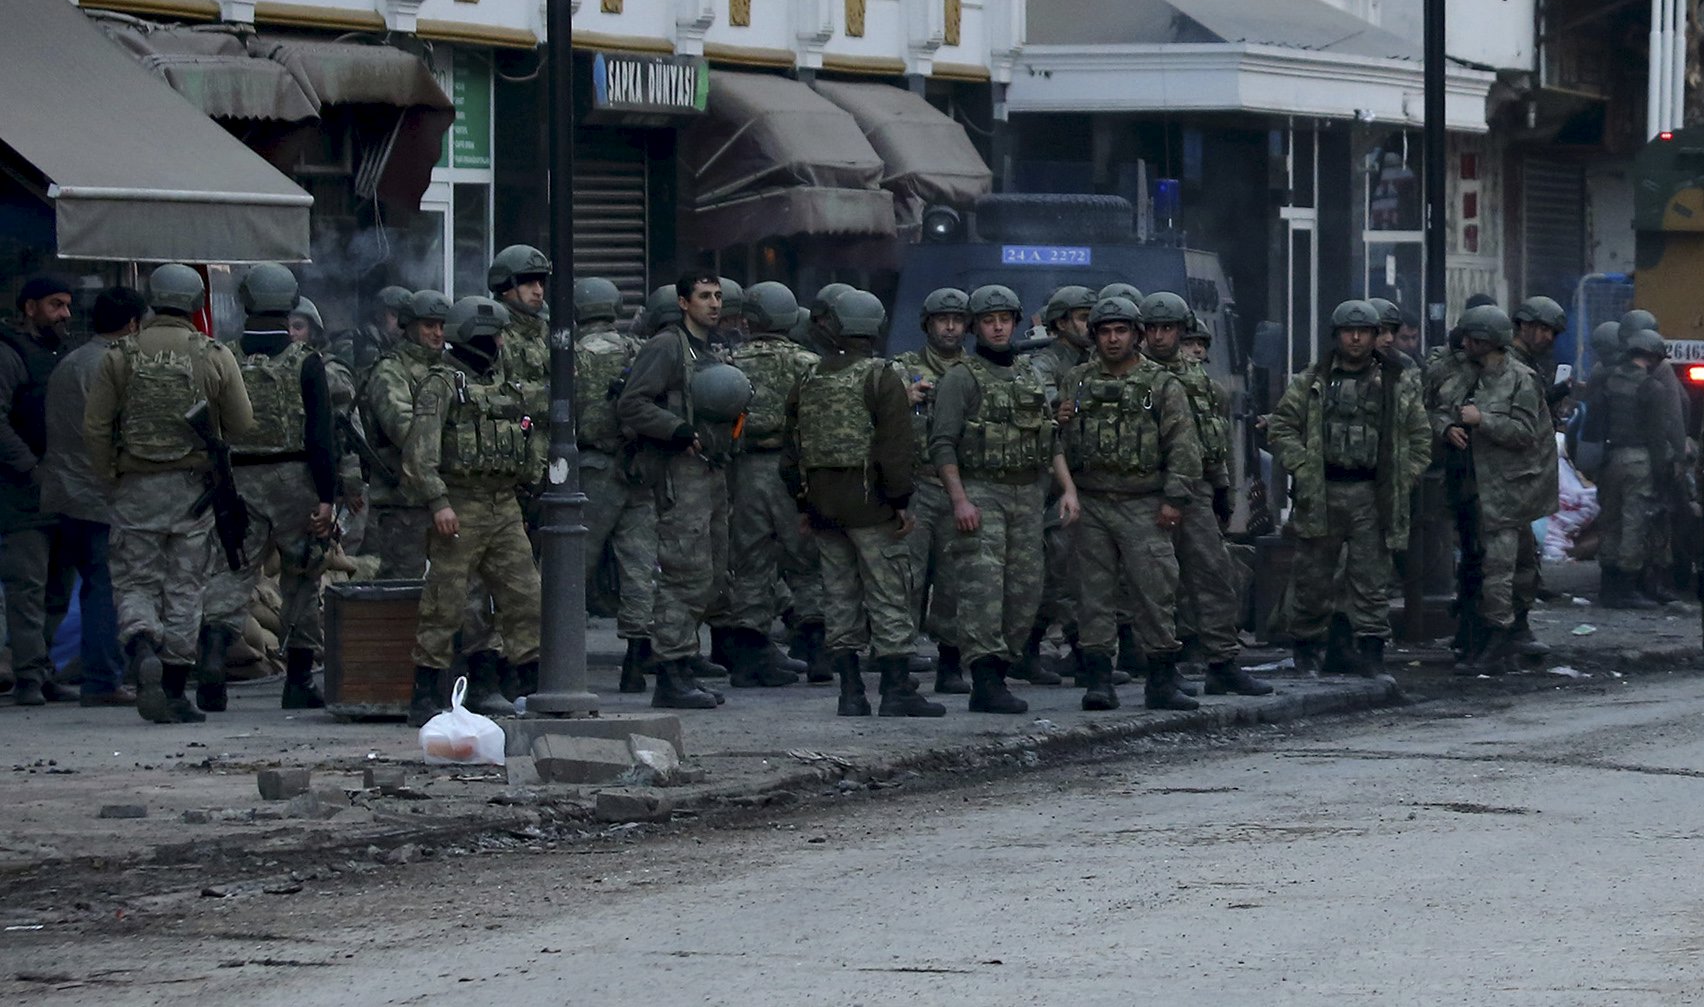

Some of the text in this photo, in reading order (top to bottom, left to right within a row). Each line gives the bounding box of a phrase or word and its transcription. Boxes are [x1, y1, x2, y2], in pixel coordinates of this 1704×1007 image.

[607, 57, 695, 108] ŞAPKA DÜNYASI
[1008, 249, 1086, 262] 24 A 2272
